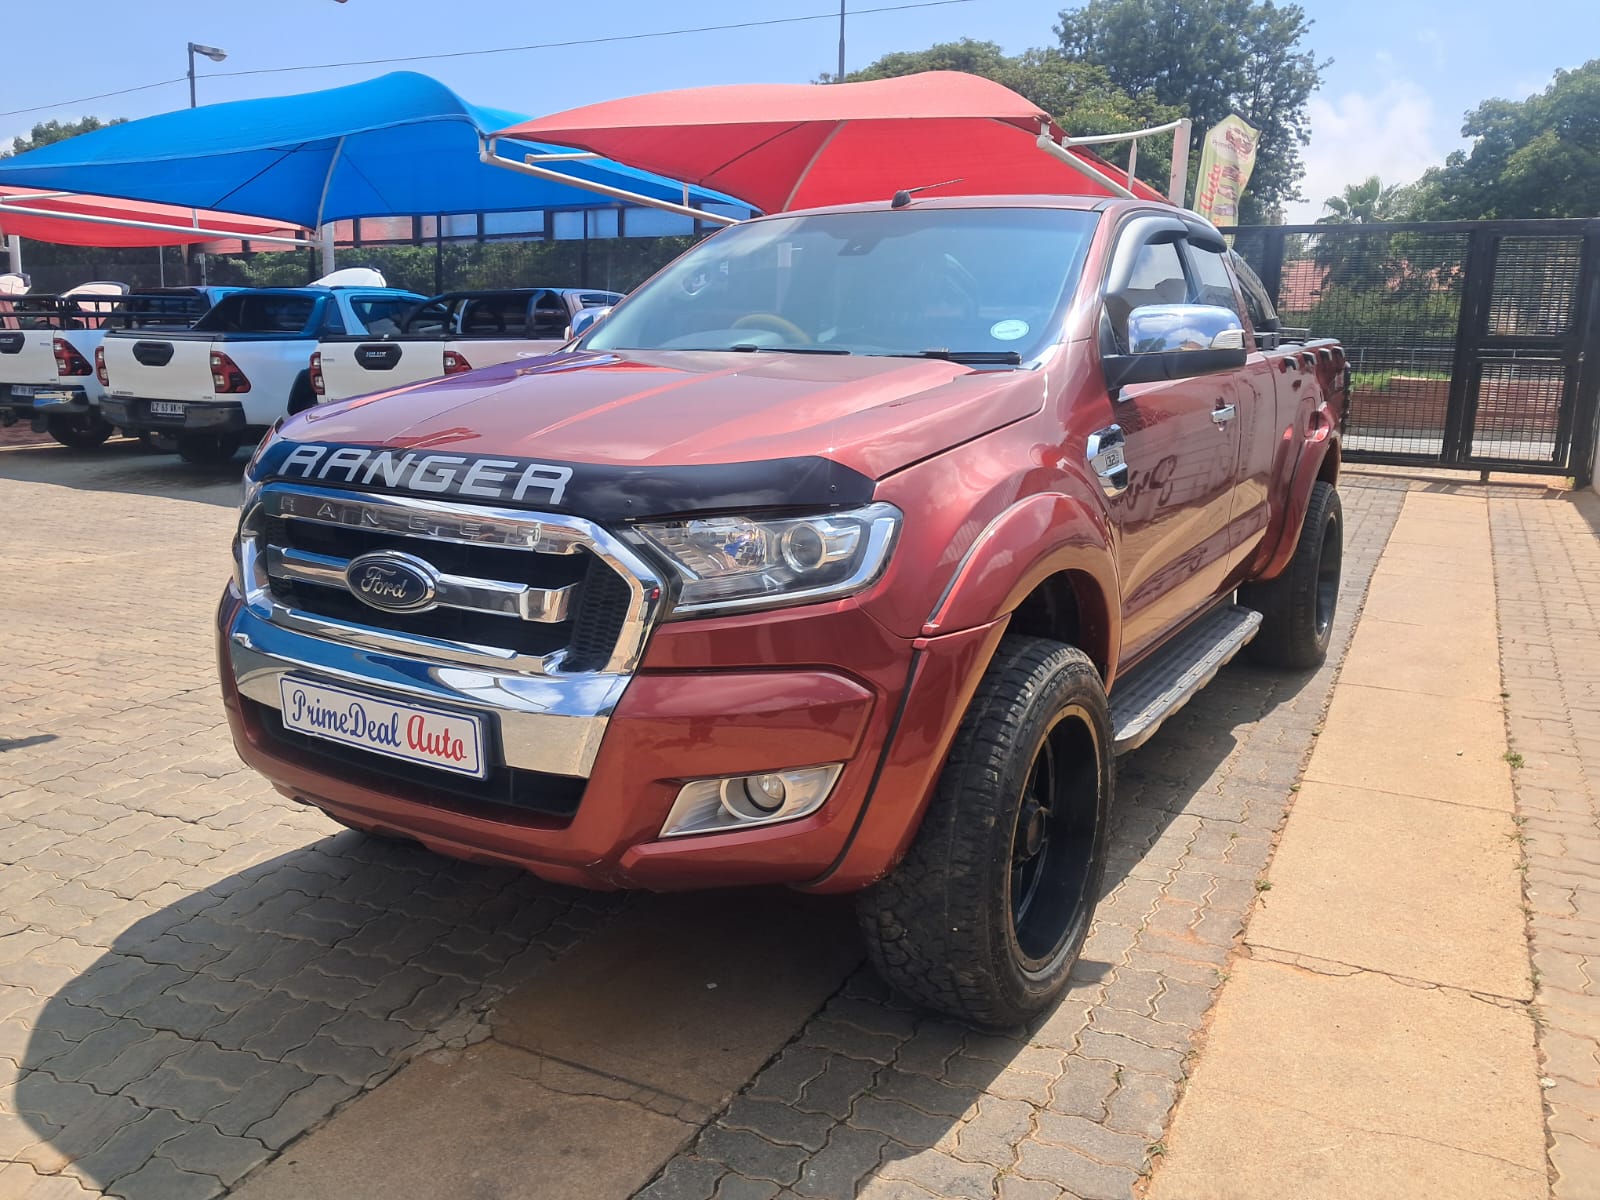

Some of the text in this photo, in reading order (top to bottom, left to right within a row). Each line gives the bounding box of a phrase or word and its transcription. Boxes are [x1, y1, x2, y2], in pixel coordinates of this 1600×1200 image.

[278, 445, 573, 504] RANGER
[280, 496, 541, 546] RANGER
[361, 566, 407, 600] Ford
[292, 689, 467, 762] PrimeDeal Auto
